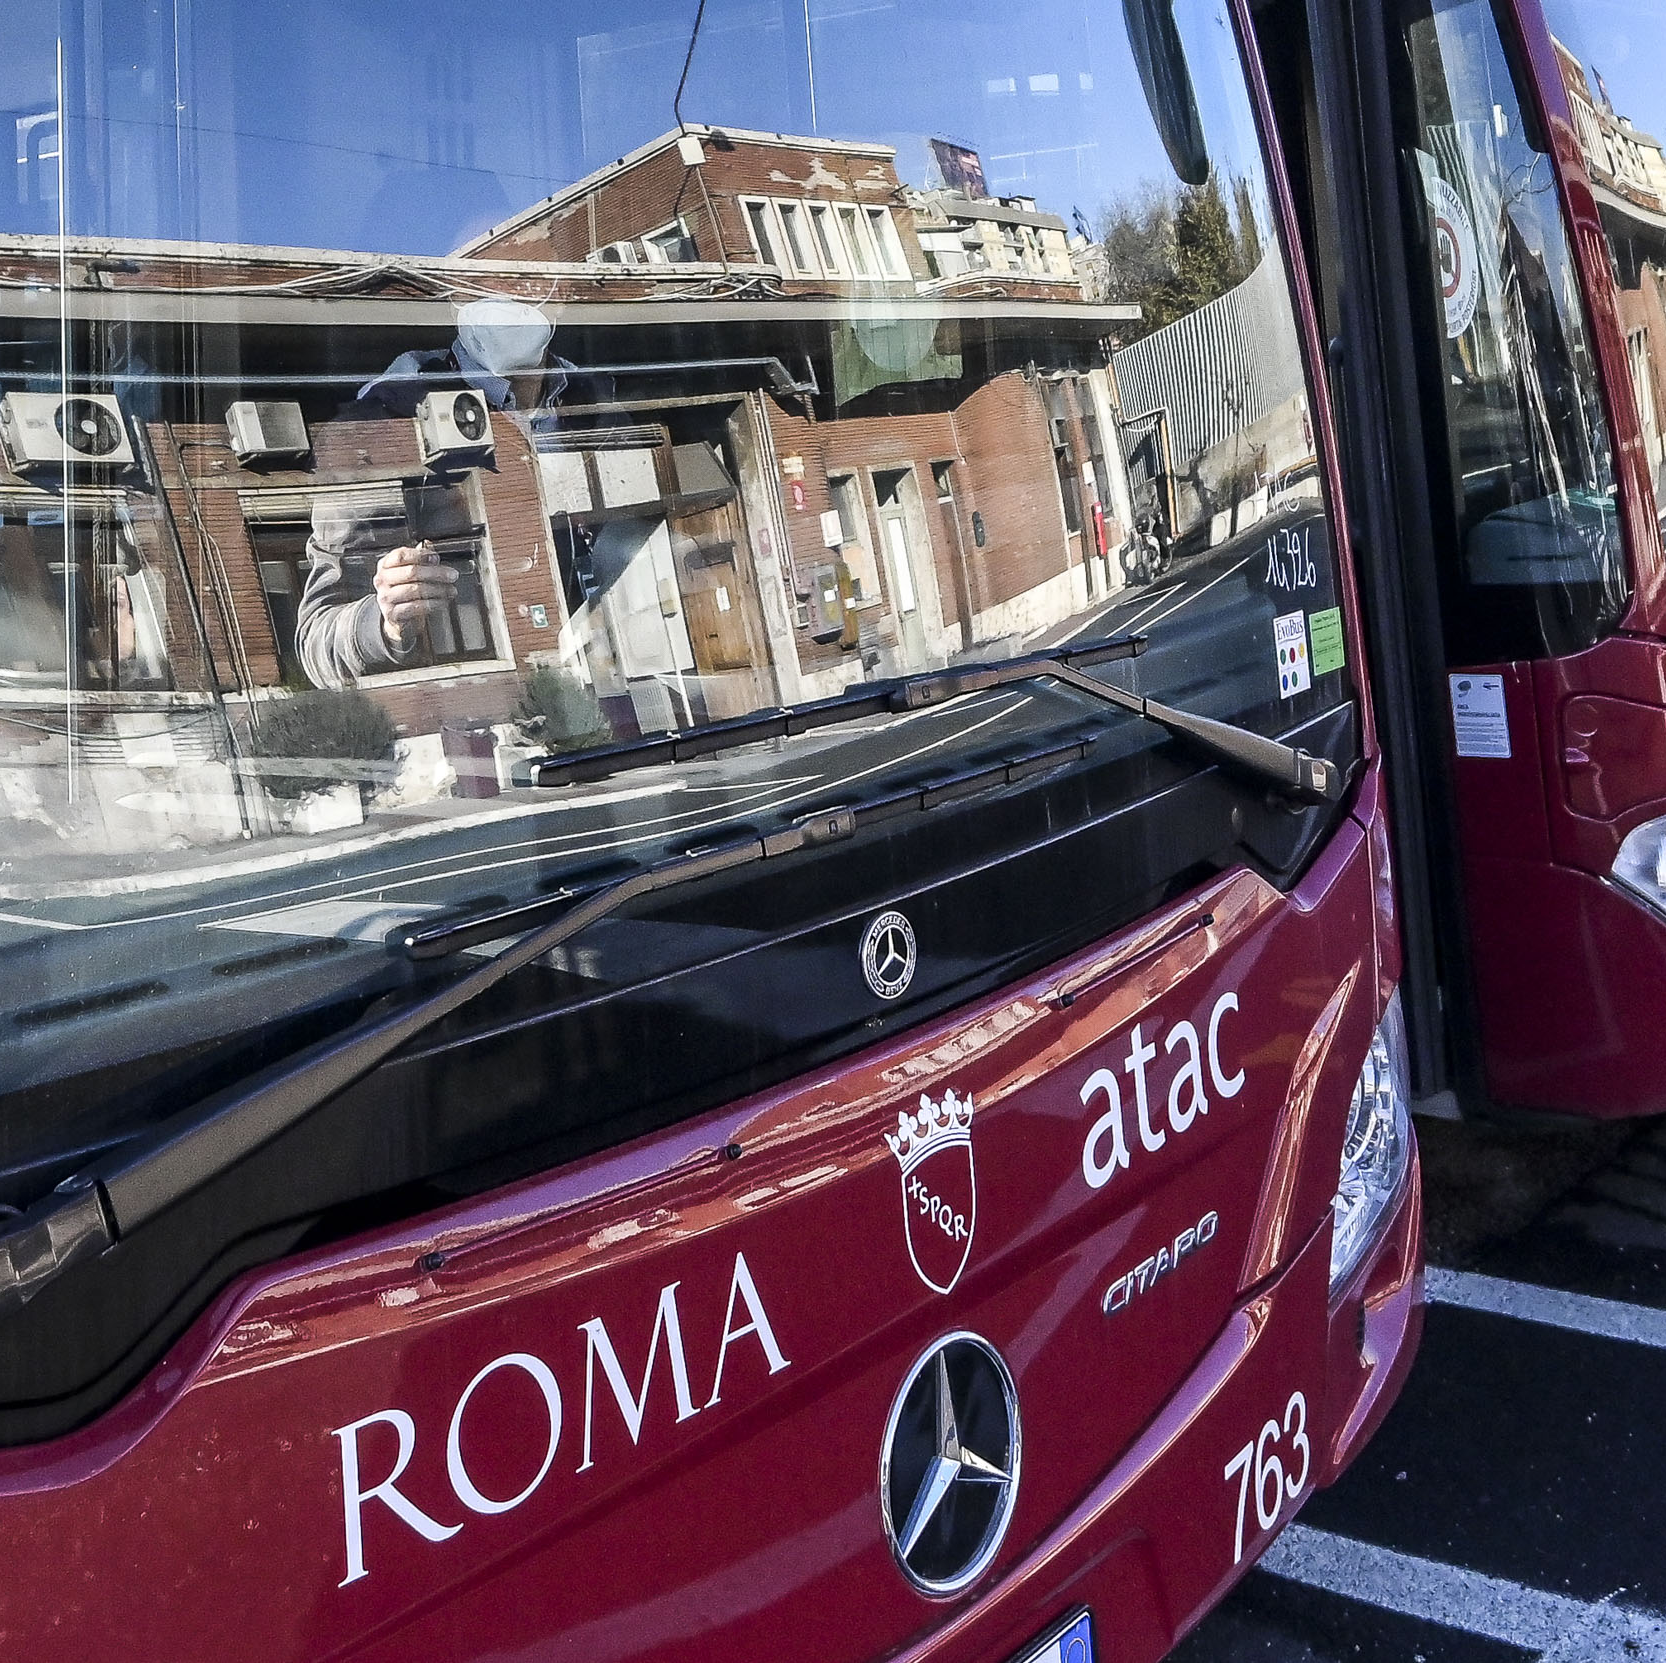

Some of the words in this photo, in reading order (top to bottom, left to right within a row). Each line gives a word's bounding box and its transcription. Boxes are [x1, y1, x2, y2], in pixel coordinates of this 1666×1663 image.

[1079, 991, 1245, 1189] atac
[1102, 1210, 1220, 1313] CITARO
[331, 1251, 791, 1588] ROMA
[1224, 1391, 1310, 1565] 763
